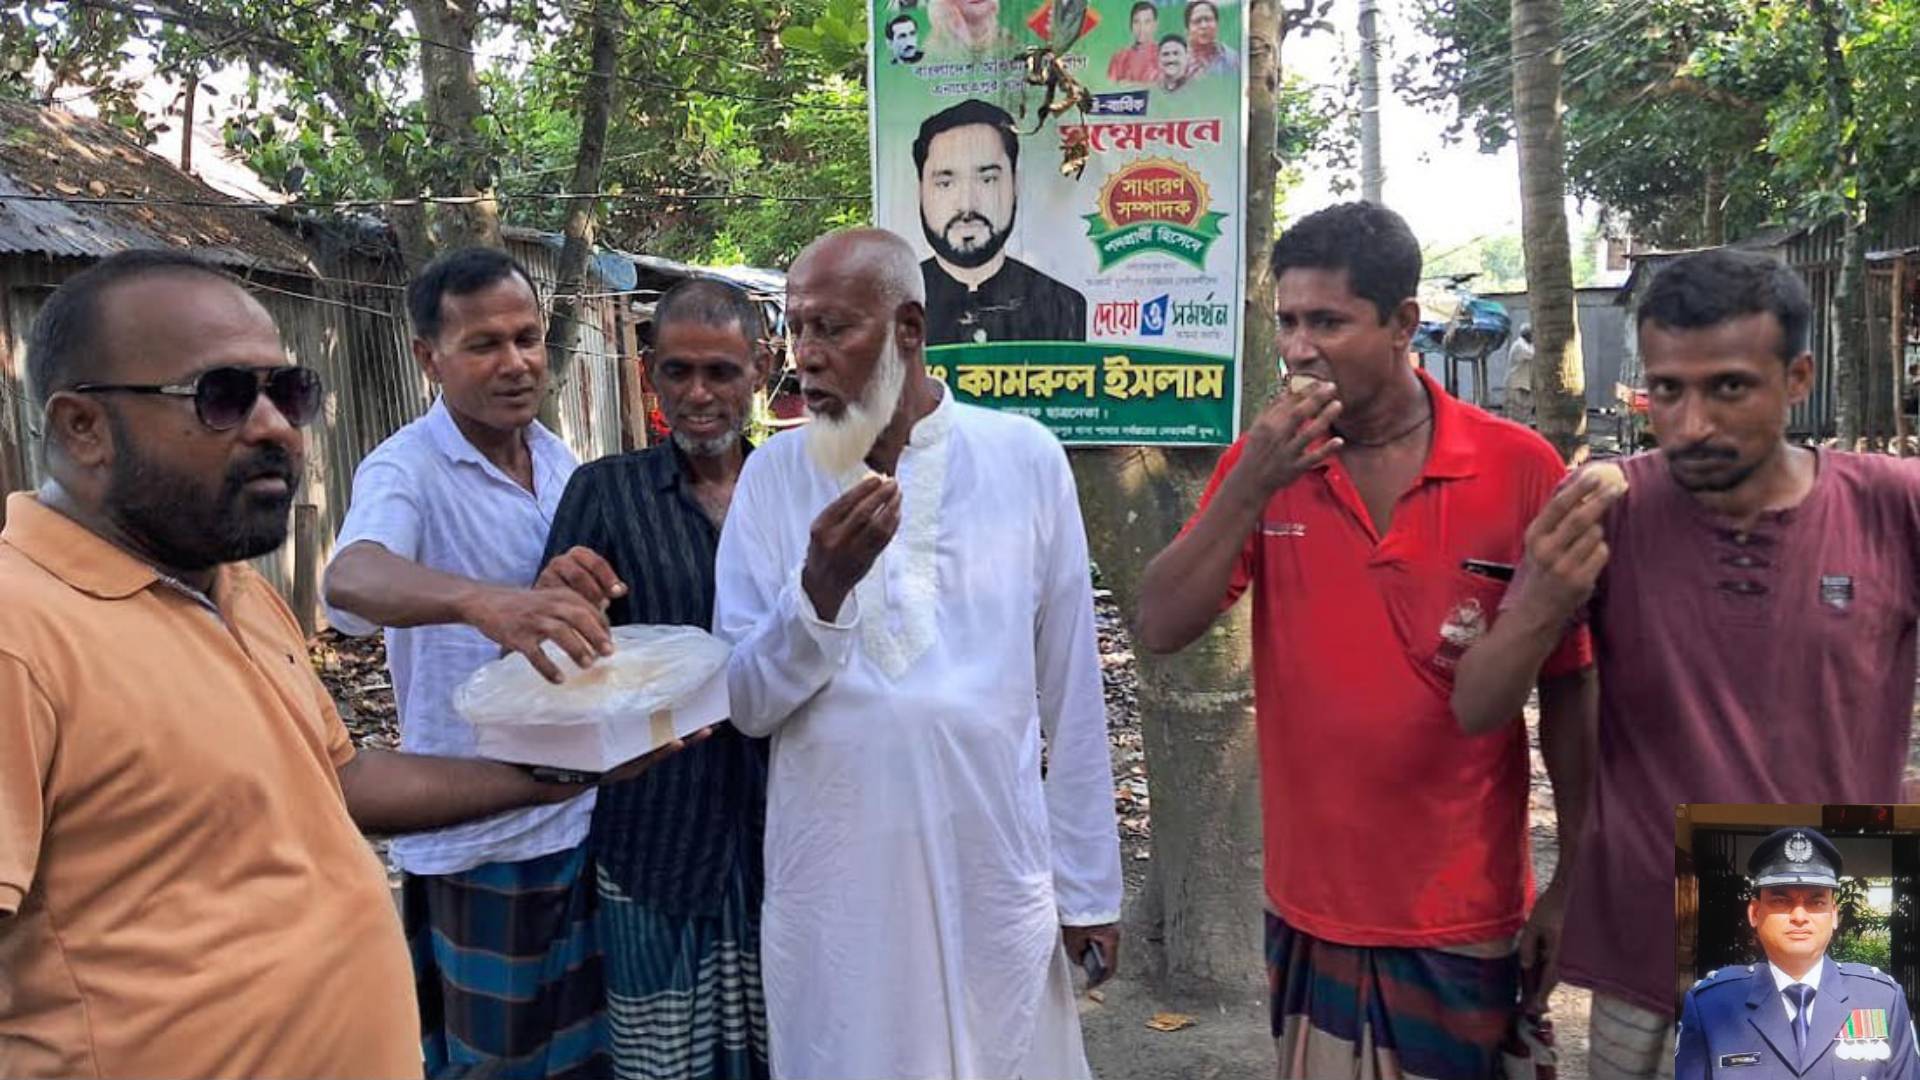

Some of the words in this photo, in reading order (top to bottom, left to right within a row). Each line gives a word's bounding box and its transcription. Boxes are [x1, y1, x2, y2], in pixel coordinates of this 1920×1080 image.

[1121, 178, 1185, 196] সাধারণ
[1115, 200, 1192, 219] সম্পাদক
[1093, 300, 1139, 336] দোয়া
[1171, 291, 1228, 327] সমর্থন
[956, 363, 1096, 398] কামরুল
[1103, 356, 1224, 399] ইসলাম
